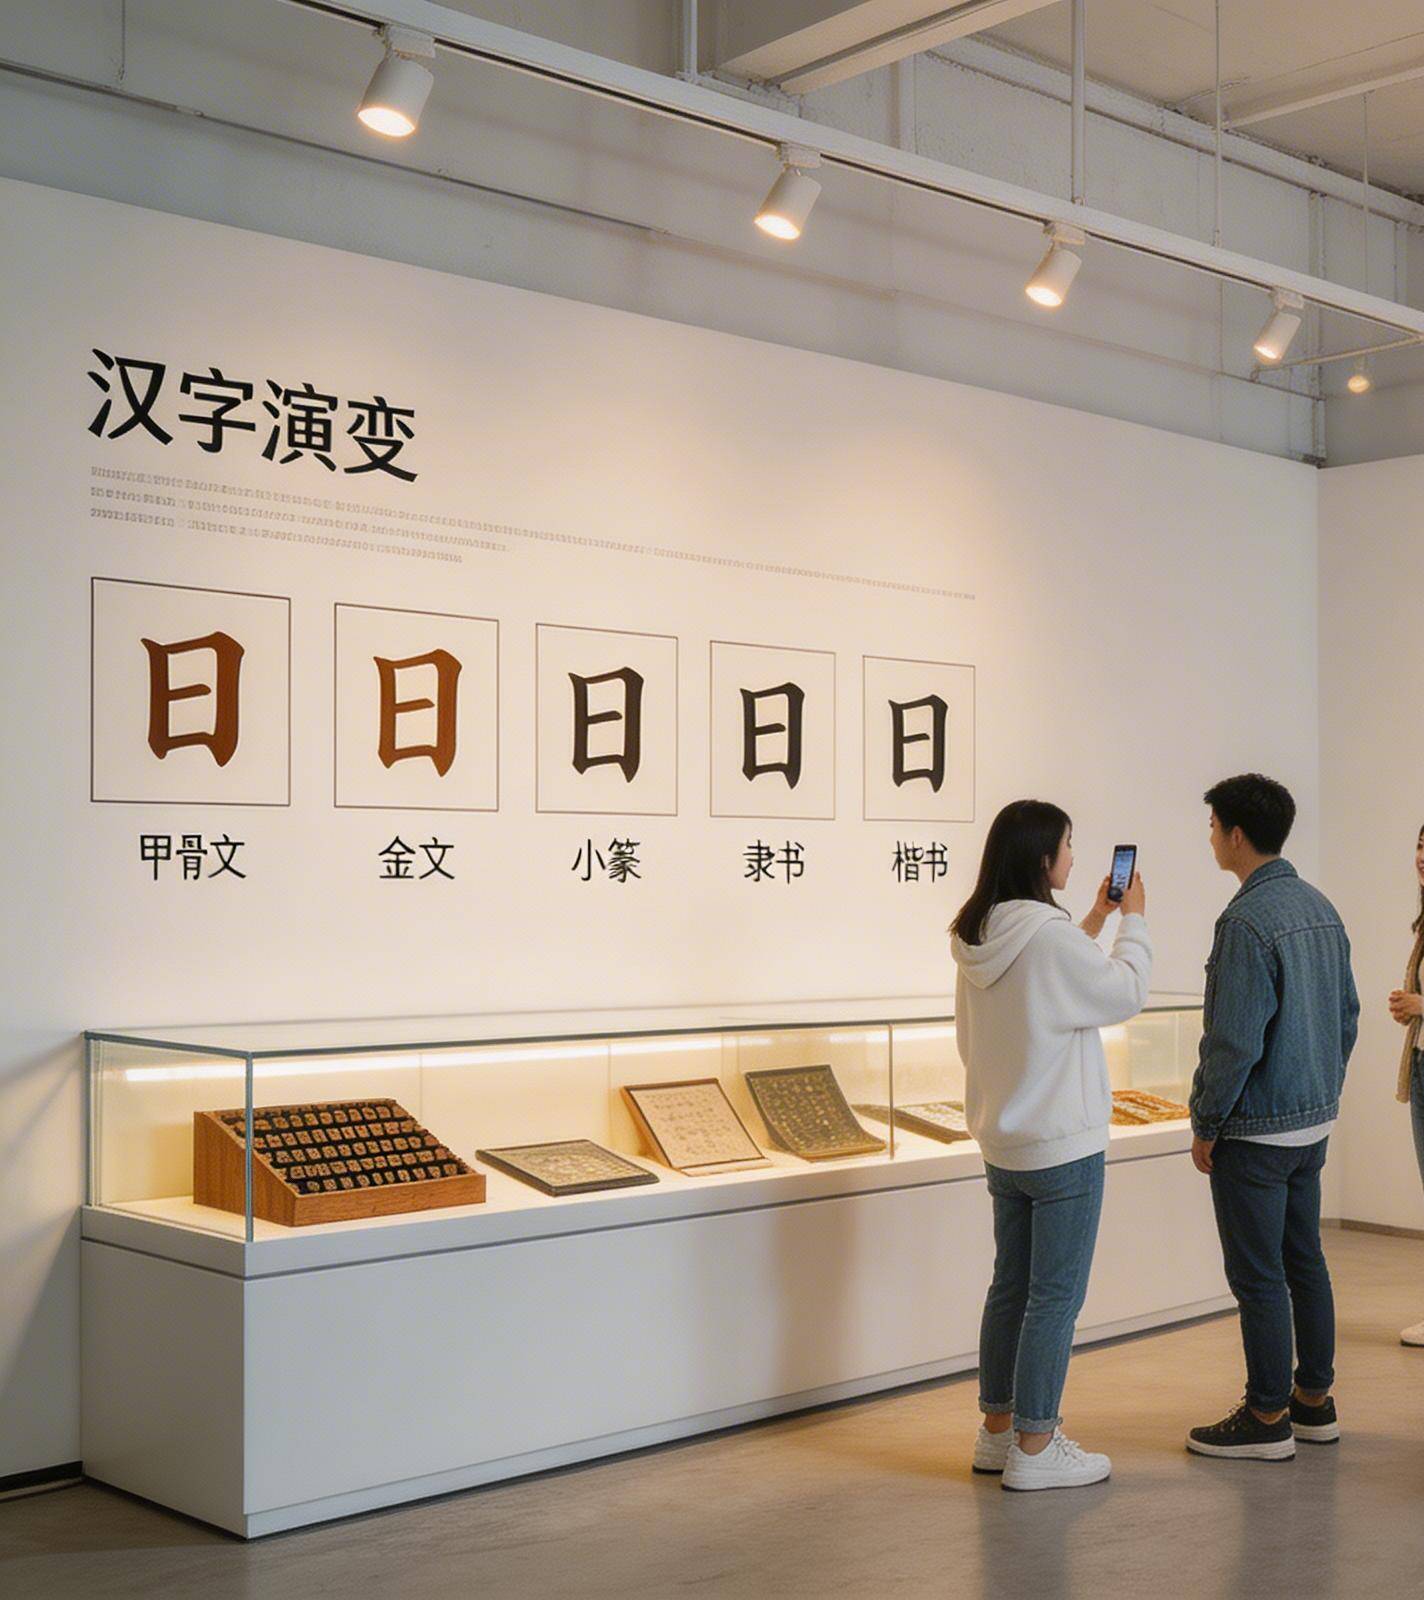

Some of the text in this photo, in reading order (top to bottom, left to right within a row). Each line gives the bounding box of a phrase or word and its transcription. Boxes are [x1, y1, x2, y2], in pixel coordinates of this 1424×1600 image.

[88, 349, 419, 484] 汉字演变
[142, 631, 247, 769] 日
[373, 648, 463, 778] 日
[568, 667, 646, 785] 日
[740, 682, 807, 791] 日
[888, 694, 950, 795] 日
[140, 834, 248, 882] 甲骨文
[378, 836, 457, 882] 金文
[571, 838, 643, 885] 小篆
[743, 840, 806, 885] 隶书
[892, 841, 950, 884] 楷书
